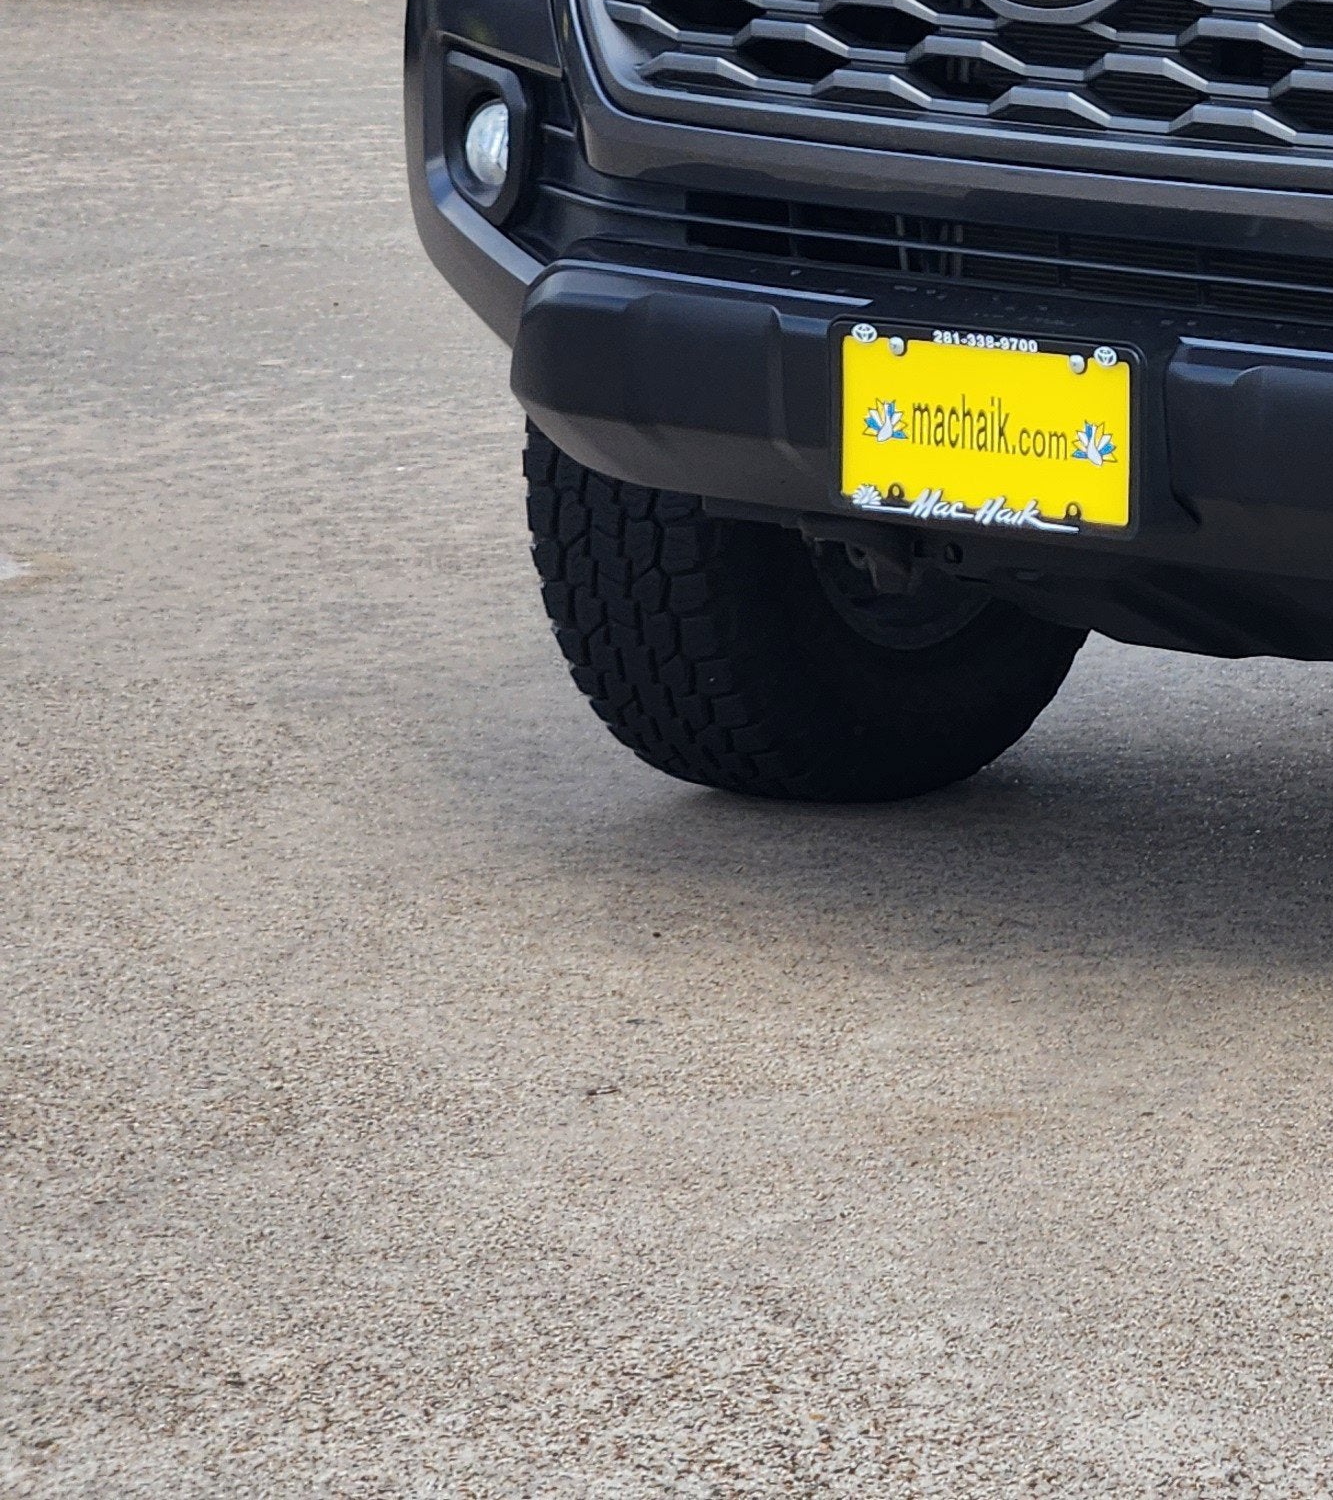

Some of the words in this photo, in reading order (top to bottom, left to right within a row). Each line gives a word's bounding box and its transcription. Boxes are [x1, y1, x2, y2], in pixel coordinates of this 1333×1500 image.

[932, 330, 1038, 353] 281-338-9700
[911, 394, 1068, 461] machaik.com
[907, 488, 972, 520] Mac
[973, 495, 1044, 528] Haik
